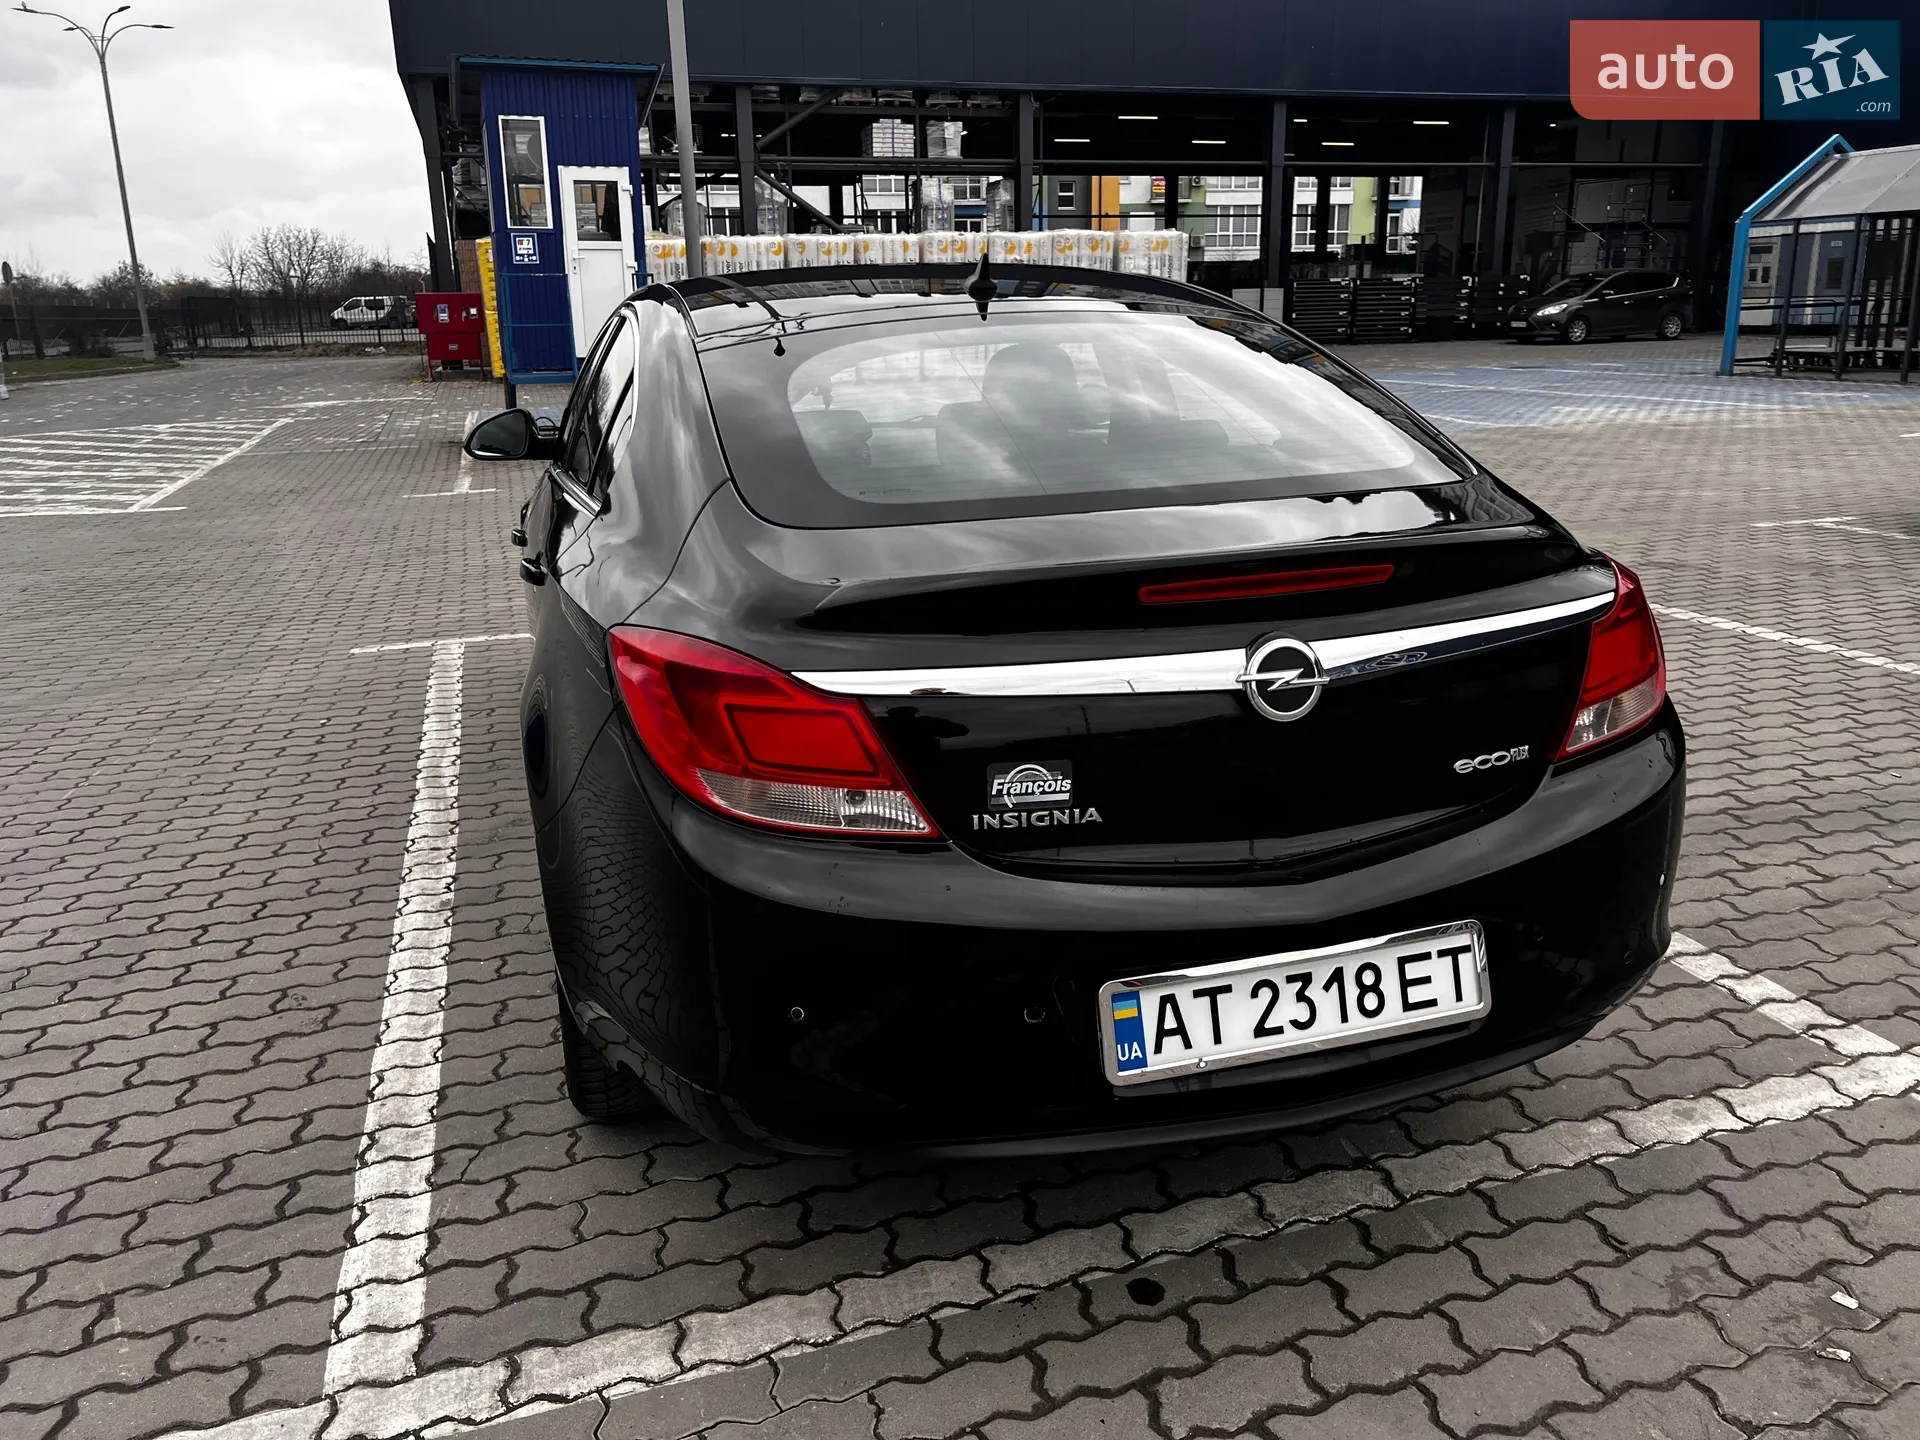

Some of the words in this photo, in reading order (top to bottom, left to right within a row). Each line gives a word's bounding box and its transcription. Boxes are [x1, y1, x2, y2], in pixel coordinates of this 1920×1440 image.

[991, 776, 1072, 797] François
[972, 807, 1103, 830] INSIGNIA
[1153, 984, 1233, 1055] AT
[1250, 962, 1386, 1039] 2318
[1396, 944, 1473, 1013] ET
[1117, 1041, 1143, 1061] UA
